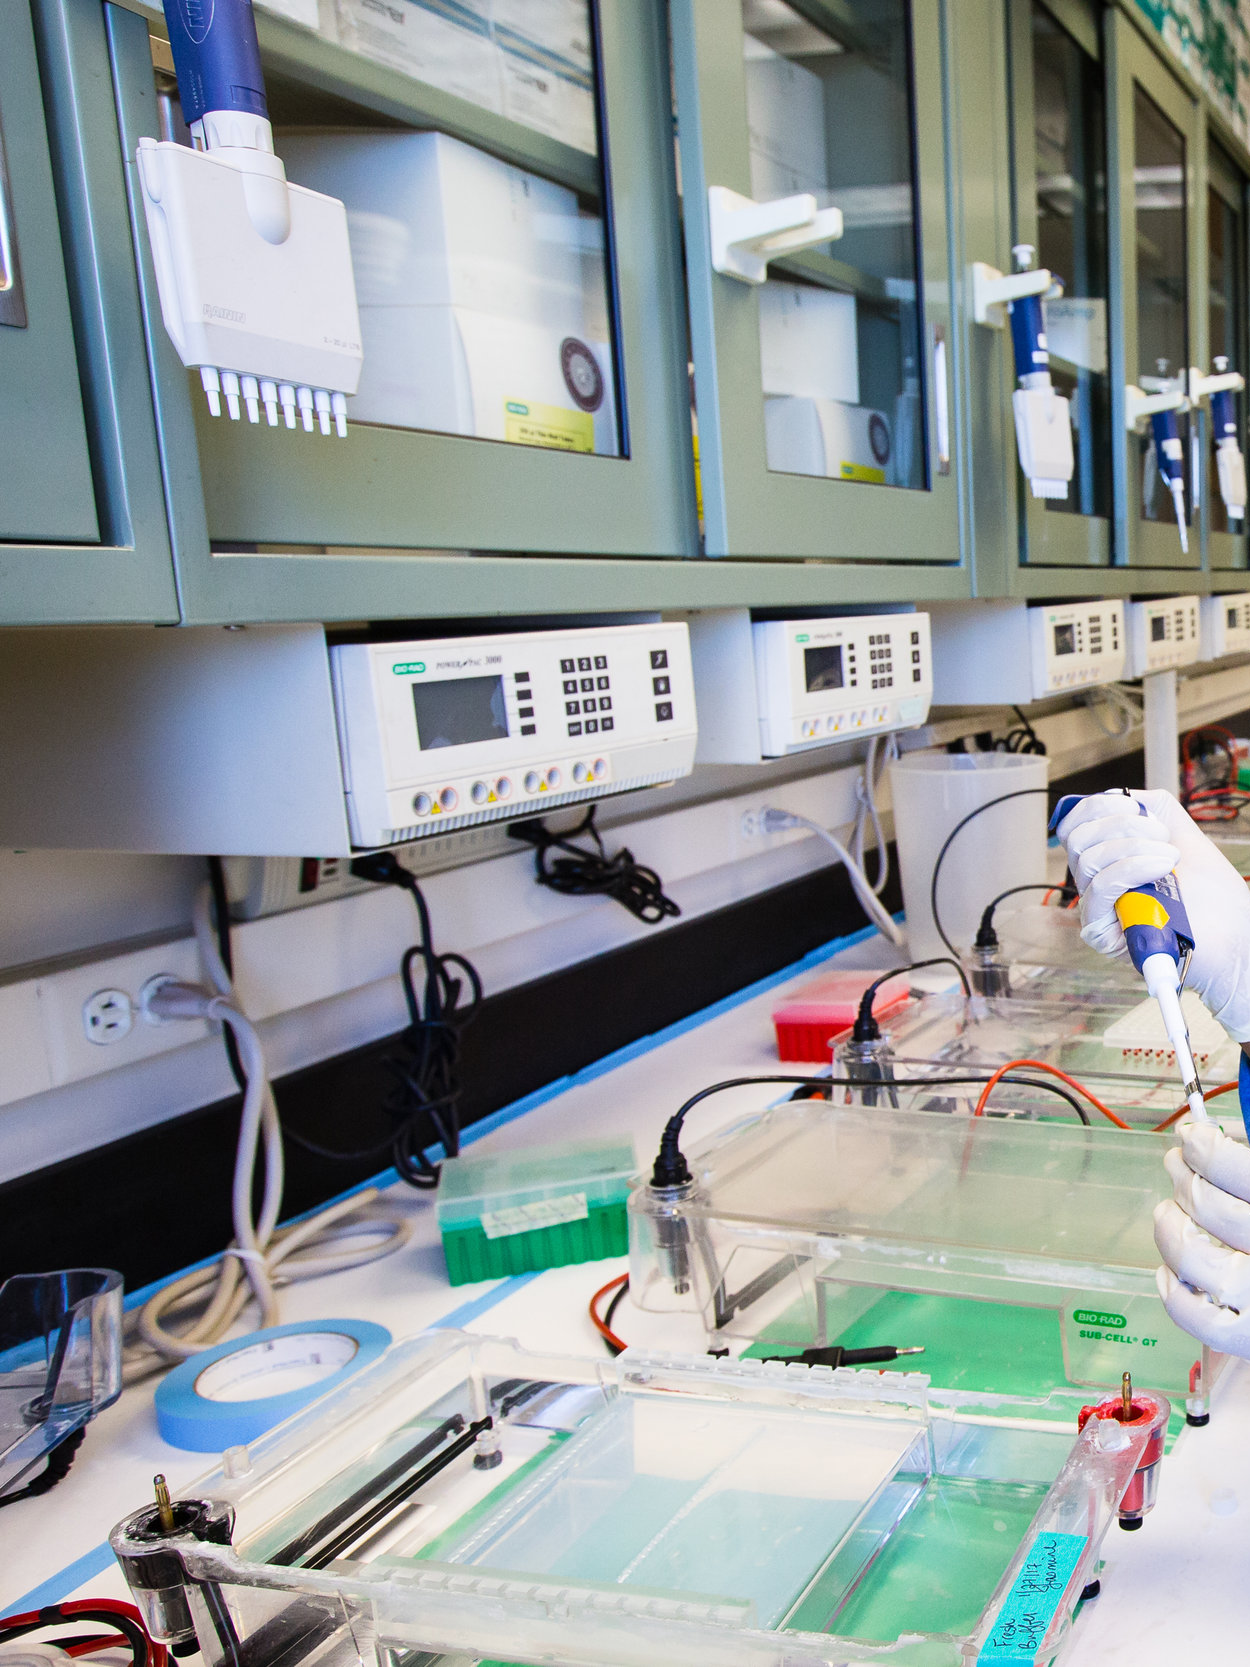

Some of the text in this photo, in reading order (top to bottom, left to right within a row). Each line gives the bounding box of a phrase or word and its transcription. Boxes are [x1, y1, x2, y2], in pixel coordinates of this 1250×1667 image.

[203, 303, 246, 323] RAININ
[1078, 1312, 1123, 1326] BIO-RAD
[1142, 1337, 1158, 1347] GT
[992, 1618, 1017, 1647] Fresh
[1018, 1612, 1046, 1650] Buffer
